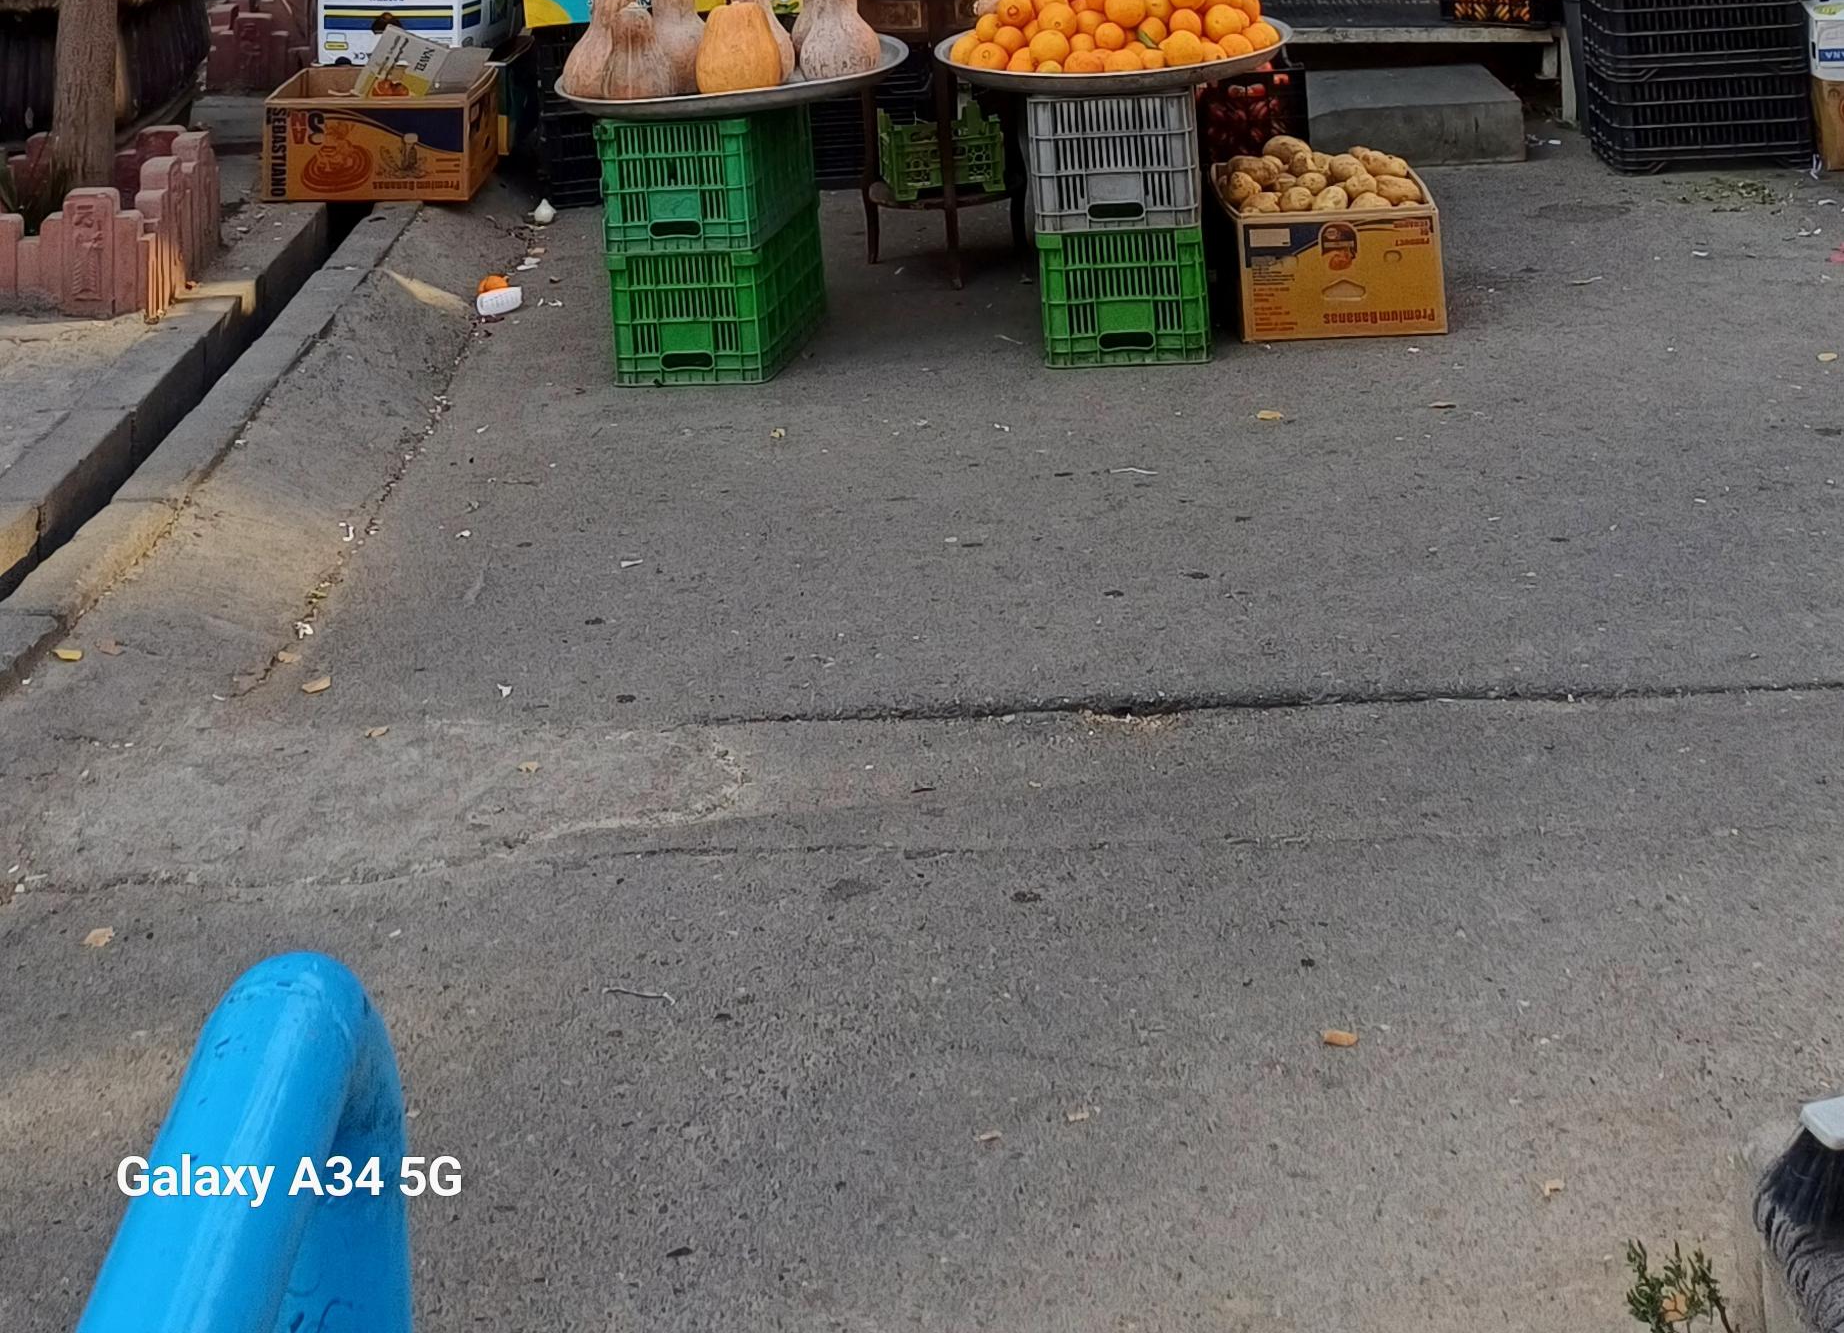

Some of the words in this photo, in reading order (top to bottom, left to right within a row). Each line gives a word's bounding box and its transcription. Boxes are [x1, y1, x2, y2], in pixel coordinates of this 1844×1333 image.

[414, 46, 436, 72] NAVEL
[270, 107, 287, 197] SEBASTIANO
[372, 180, 415, 191] Bananas
[416, 179, 460, 191] Premium
[1323, 311, 1378, 326] Bananas
[1379, 308, 1435, 323] Premium
